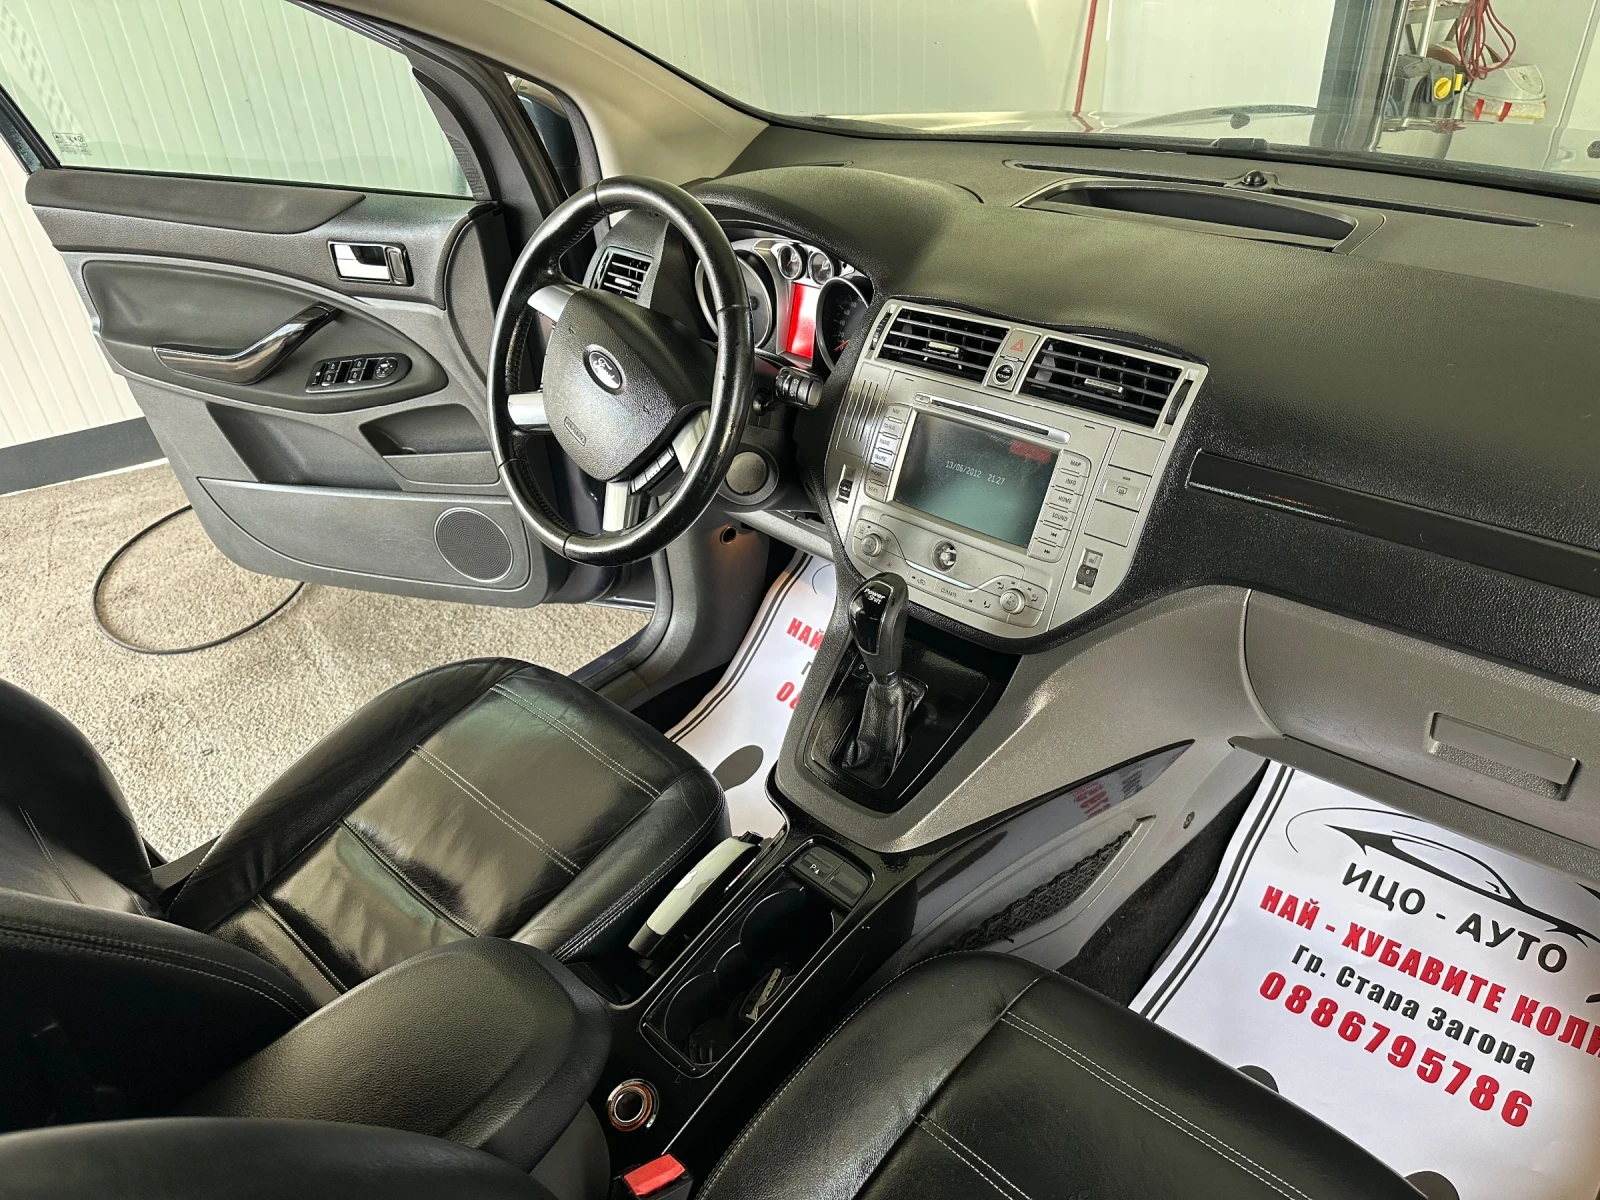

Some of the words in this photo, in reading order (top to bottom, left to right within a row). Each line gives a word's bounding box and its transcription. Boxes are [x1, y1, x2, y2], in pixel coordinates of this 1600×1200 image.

[1069, 460, 1082, 468] MAP
[987, 473, 1006, 486] 21:27
[1065, 478, 1077, 486] INFO
[1058, 495, 1073, 505] HOME
[1051, 512, 1069, 522] SOUND
[864, 588, 886, 600] Power
[786, 617, 825, 651] НАЙ
[1342, 862, 1426, 915] ИЦО
[1455, 912, 1568, 974] АУТО
[1259, 885, 1321, 931] НАЙ
[1341, 922, 1507, 1014] ХУБАВИТЕ
[1291, 944, 1326, 978] Гр.
[1336, 965, 1420, 1021] Стара
[1426, 1006, 1536, 1075] Загора
[1259, 971, 1534, 1129] 0886795786
